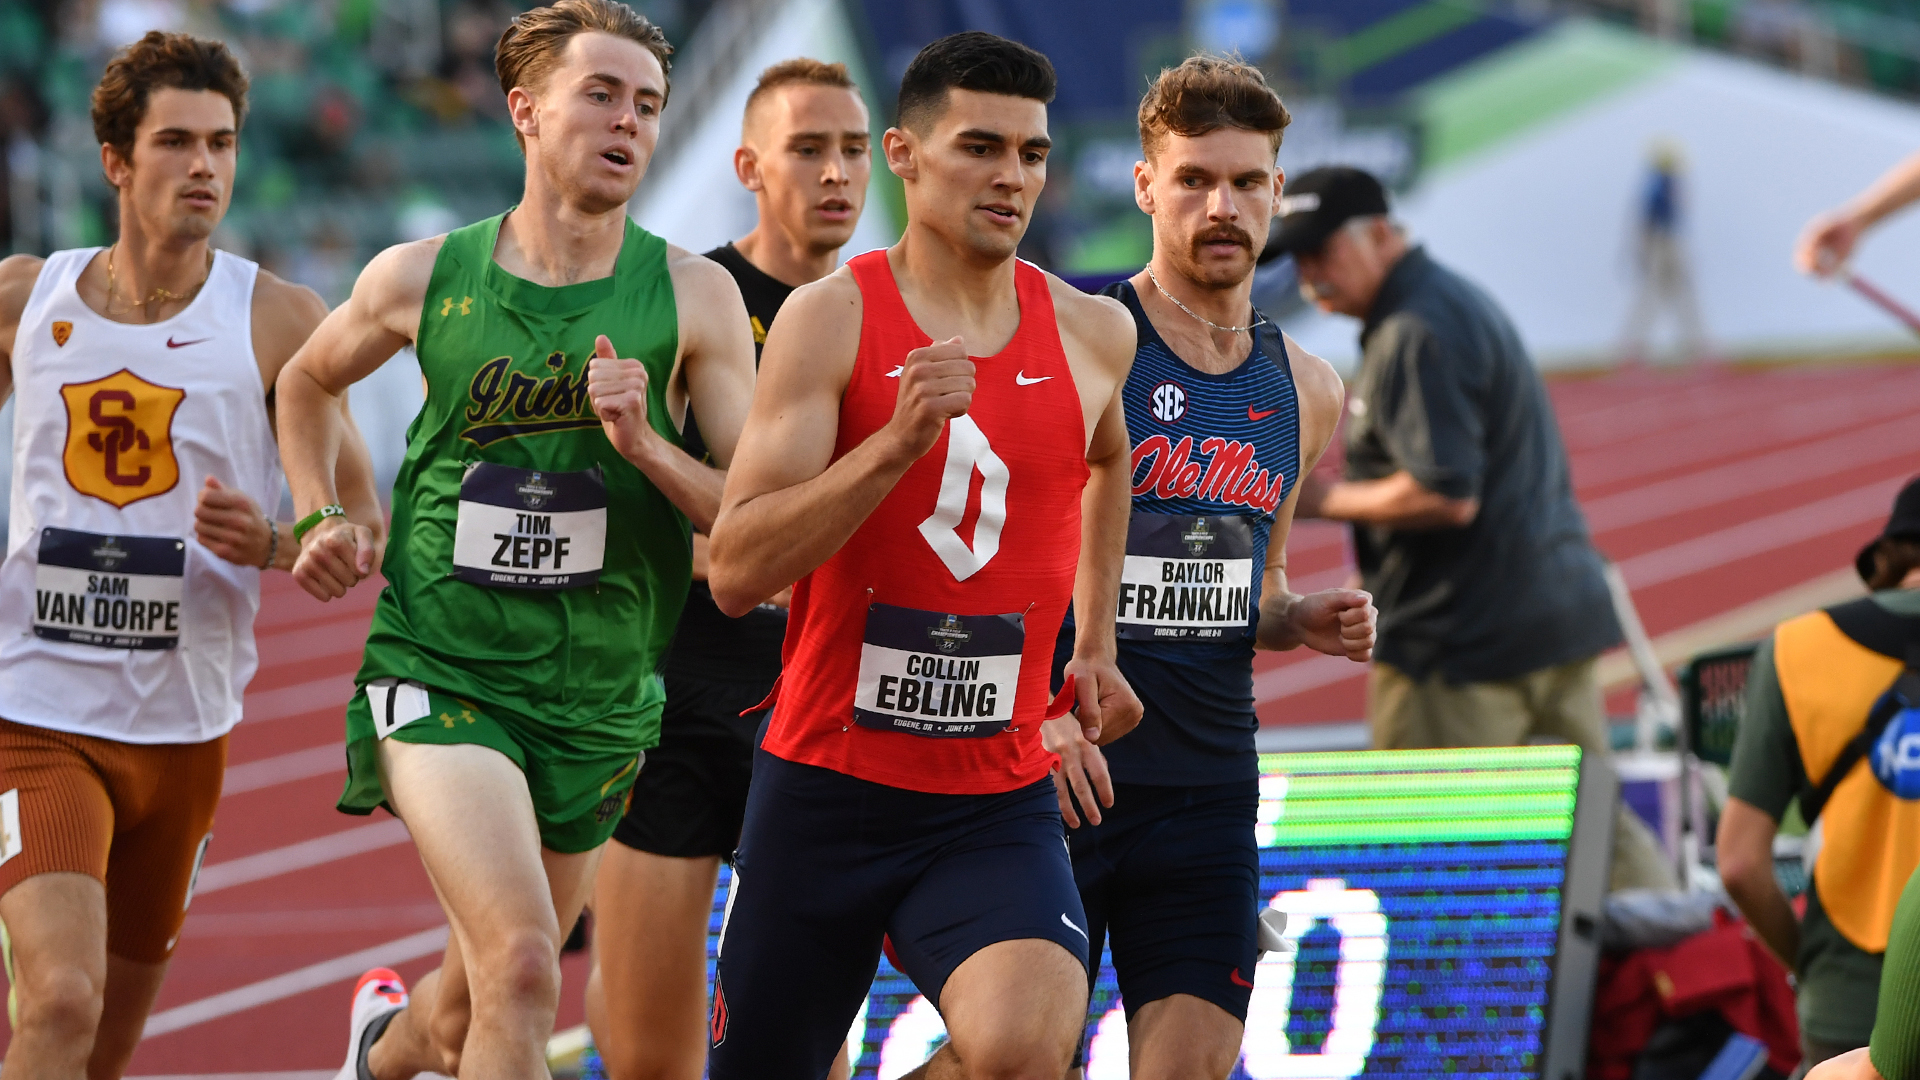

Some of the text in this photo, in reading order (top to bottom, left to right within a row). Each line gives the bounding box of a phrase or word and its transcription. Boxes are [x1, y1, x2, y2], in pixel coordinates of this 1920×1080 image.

[1152, 383, 1185, 421] SEC
[87, 389, 151, 486] SC
[1131, 434, 1284, 514] Ole Miss
[516, 513, 551, 535] TIM
[491, 533, 571, 569] ZEPF
[87, 573, 129, 596] SAM
[1161, 561, 1224, 583] BAYLOR
[36, 589, 180, 632] VAN DORPE
[1117, 583, 1249, 621] FRANKLIN
[906, 654, 980, 681] COLLIN
[876, 674, 998, 718] EBLING
[893, 718, 921, 730] EUGENE,
[944, 724, 963, 733] JUNE
